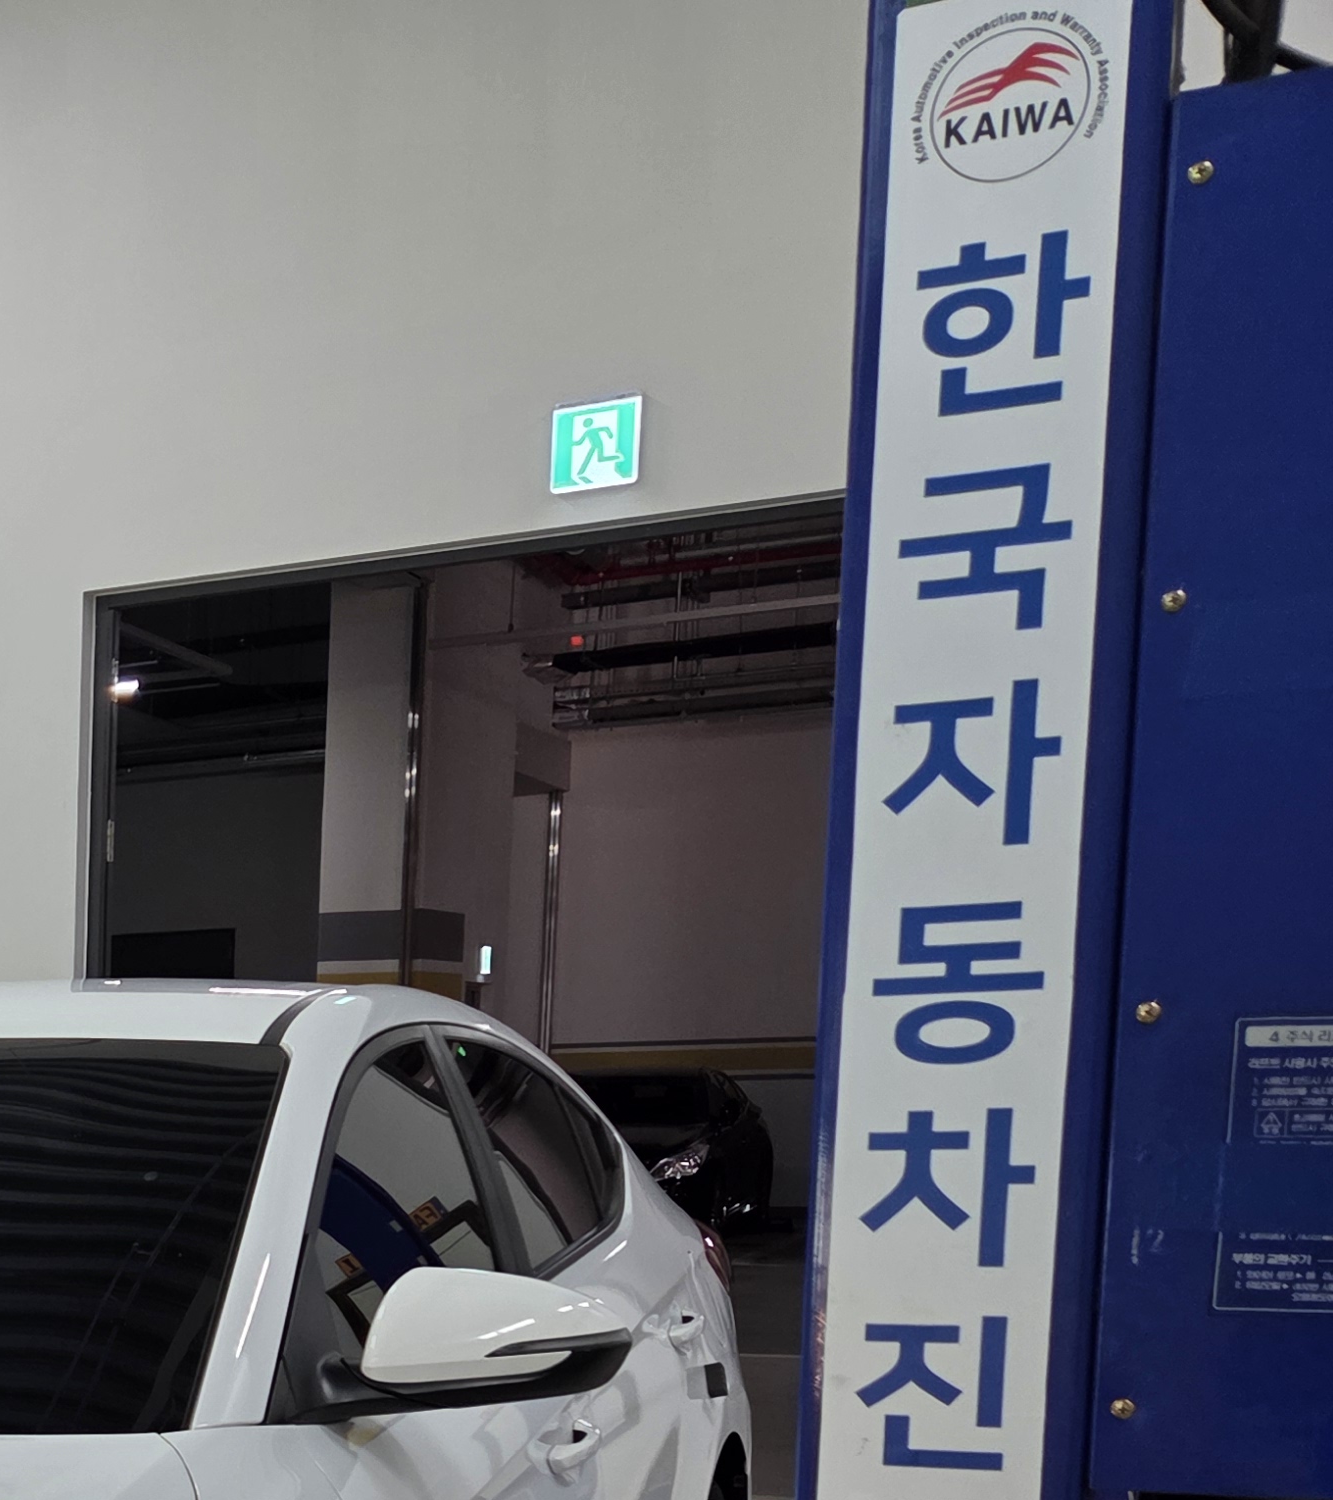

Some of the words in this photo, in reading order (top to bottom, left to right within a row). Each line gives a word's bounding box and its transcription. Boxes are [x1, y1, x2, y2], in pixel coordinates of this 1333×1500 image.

[954, 10, 1027, 50] Inspection
[1031, 10, 1058, 23] and
[1060, 13, 1103, 57] Warranty
[911, 50, 955, 123] Automotive
[1083, 59, 1110, 139] Association
[912, 126, 929, 164] Korea
[944, 97, 1075, 149] KAIWA
